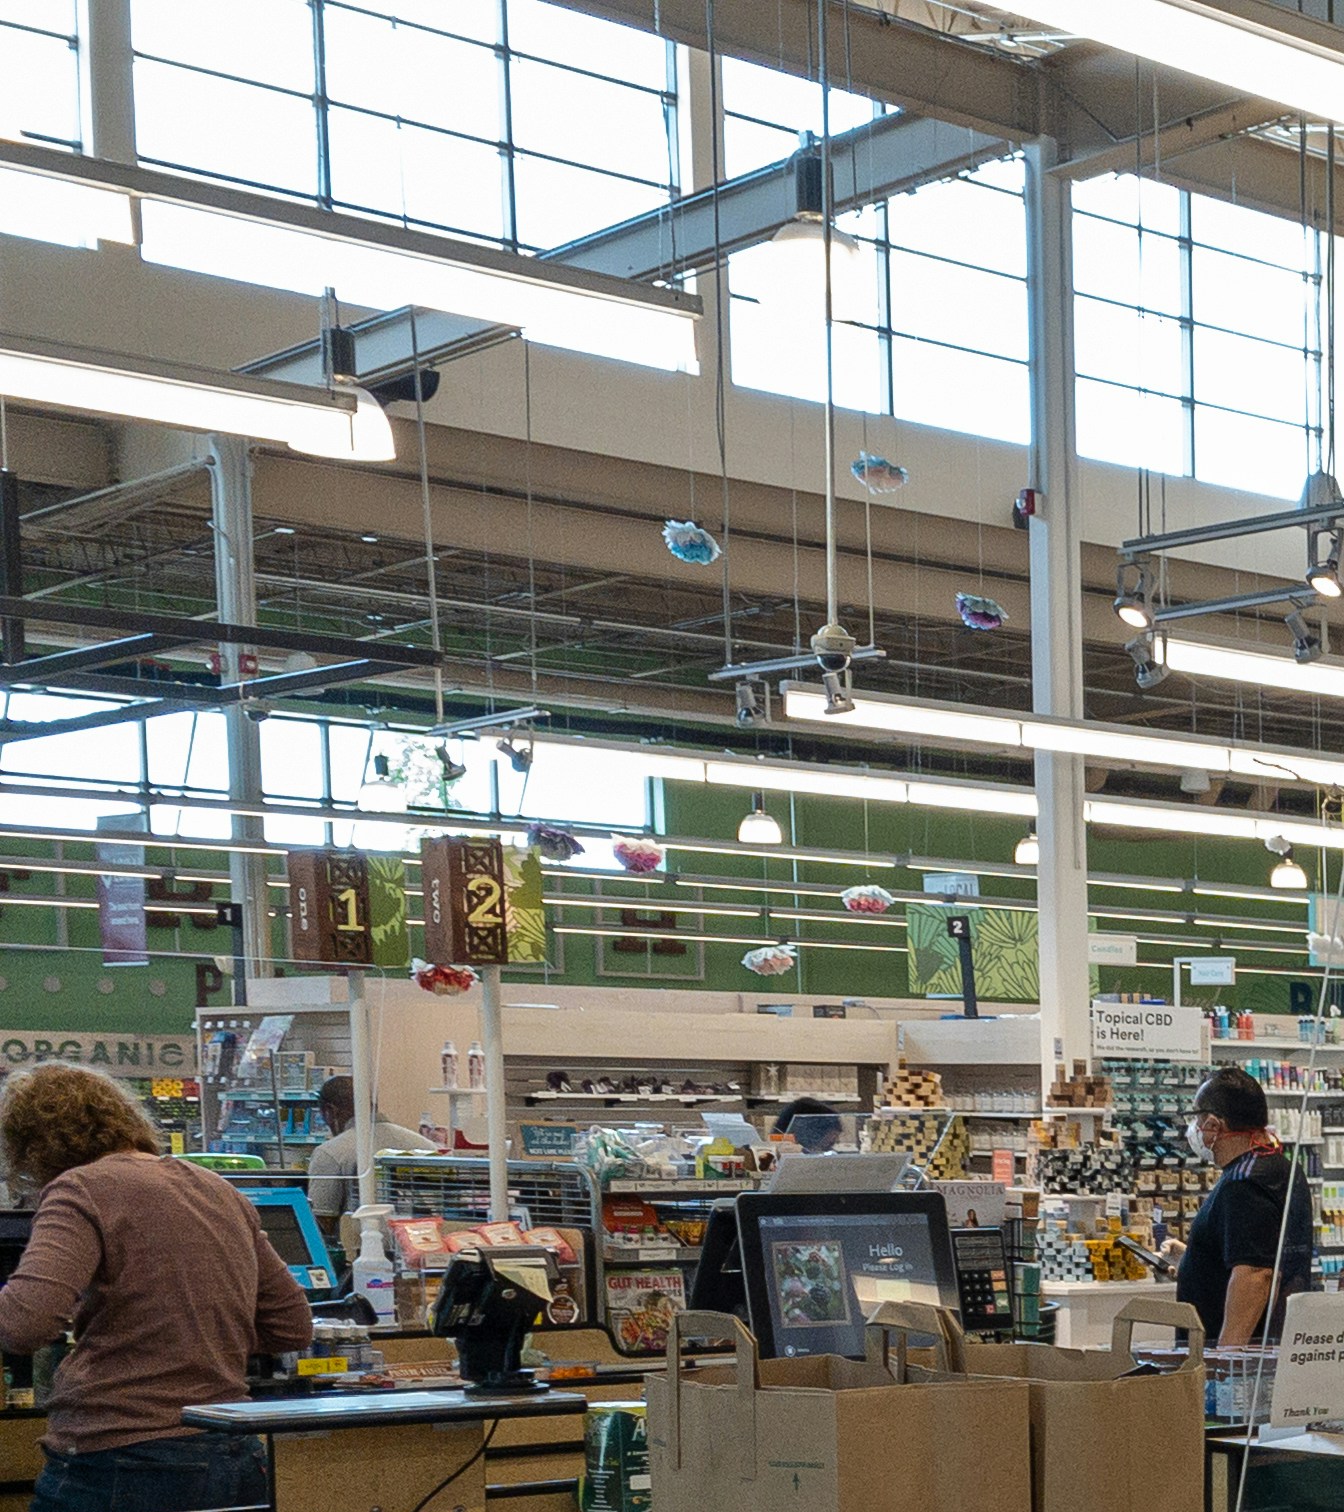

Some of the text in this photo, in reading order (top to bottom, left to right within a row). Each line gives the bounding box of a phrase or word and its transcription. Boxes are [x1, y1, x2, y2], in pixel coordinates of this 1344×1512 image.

[467, 878, 503, 925] 2
[222, 907, 232, 922] 1
[337, 888, 366, 932] 1
[952, 920, 963, 934] 2
[1096, 1010, 1173, 1026] Topical CBD
[1096, 1027, 1145, 1041] is Here!
[2, 1038, 185, 1067] ORGANIC
[936, 1184, 1005, 1196] MAGNOLIA
[869, 1244, 903, 1257] Hello
[608, 1276, 681, 1289] GUT HEALTH
[1293, 1332, 1333, 1345] Please
[1290, 1349, 1336, 1365] against
[1284, 1407, 1329, 1418] Thank You
